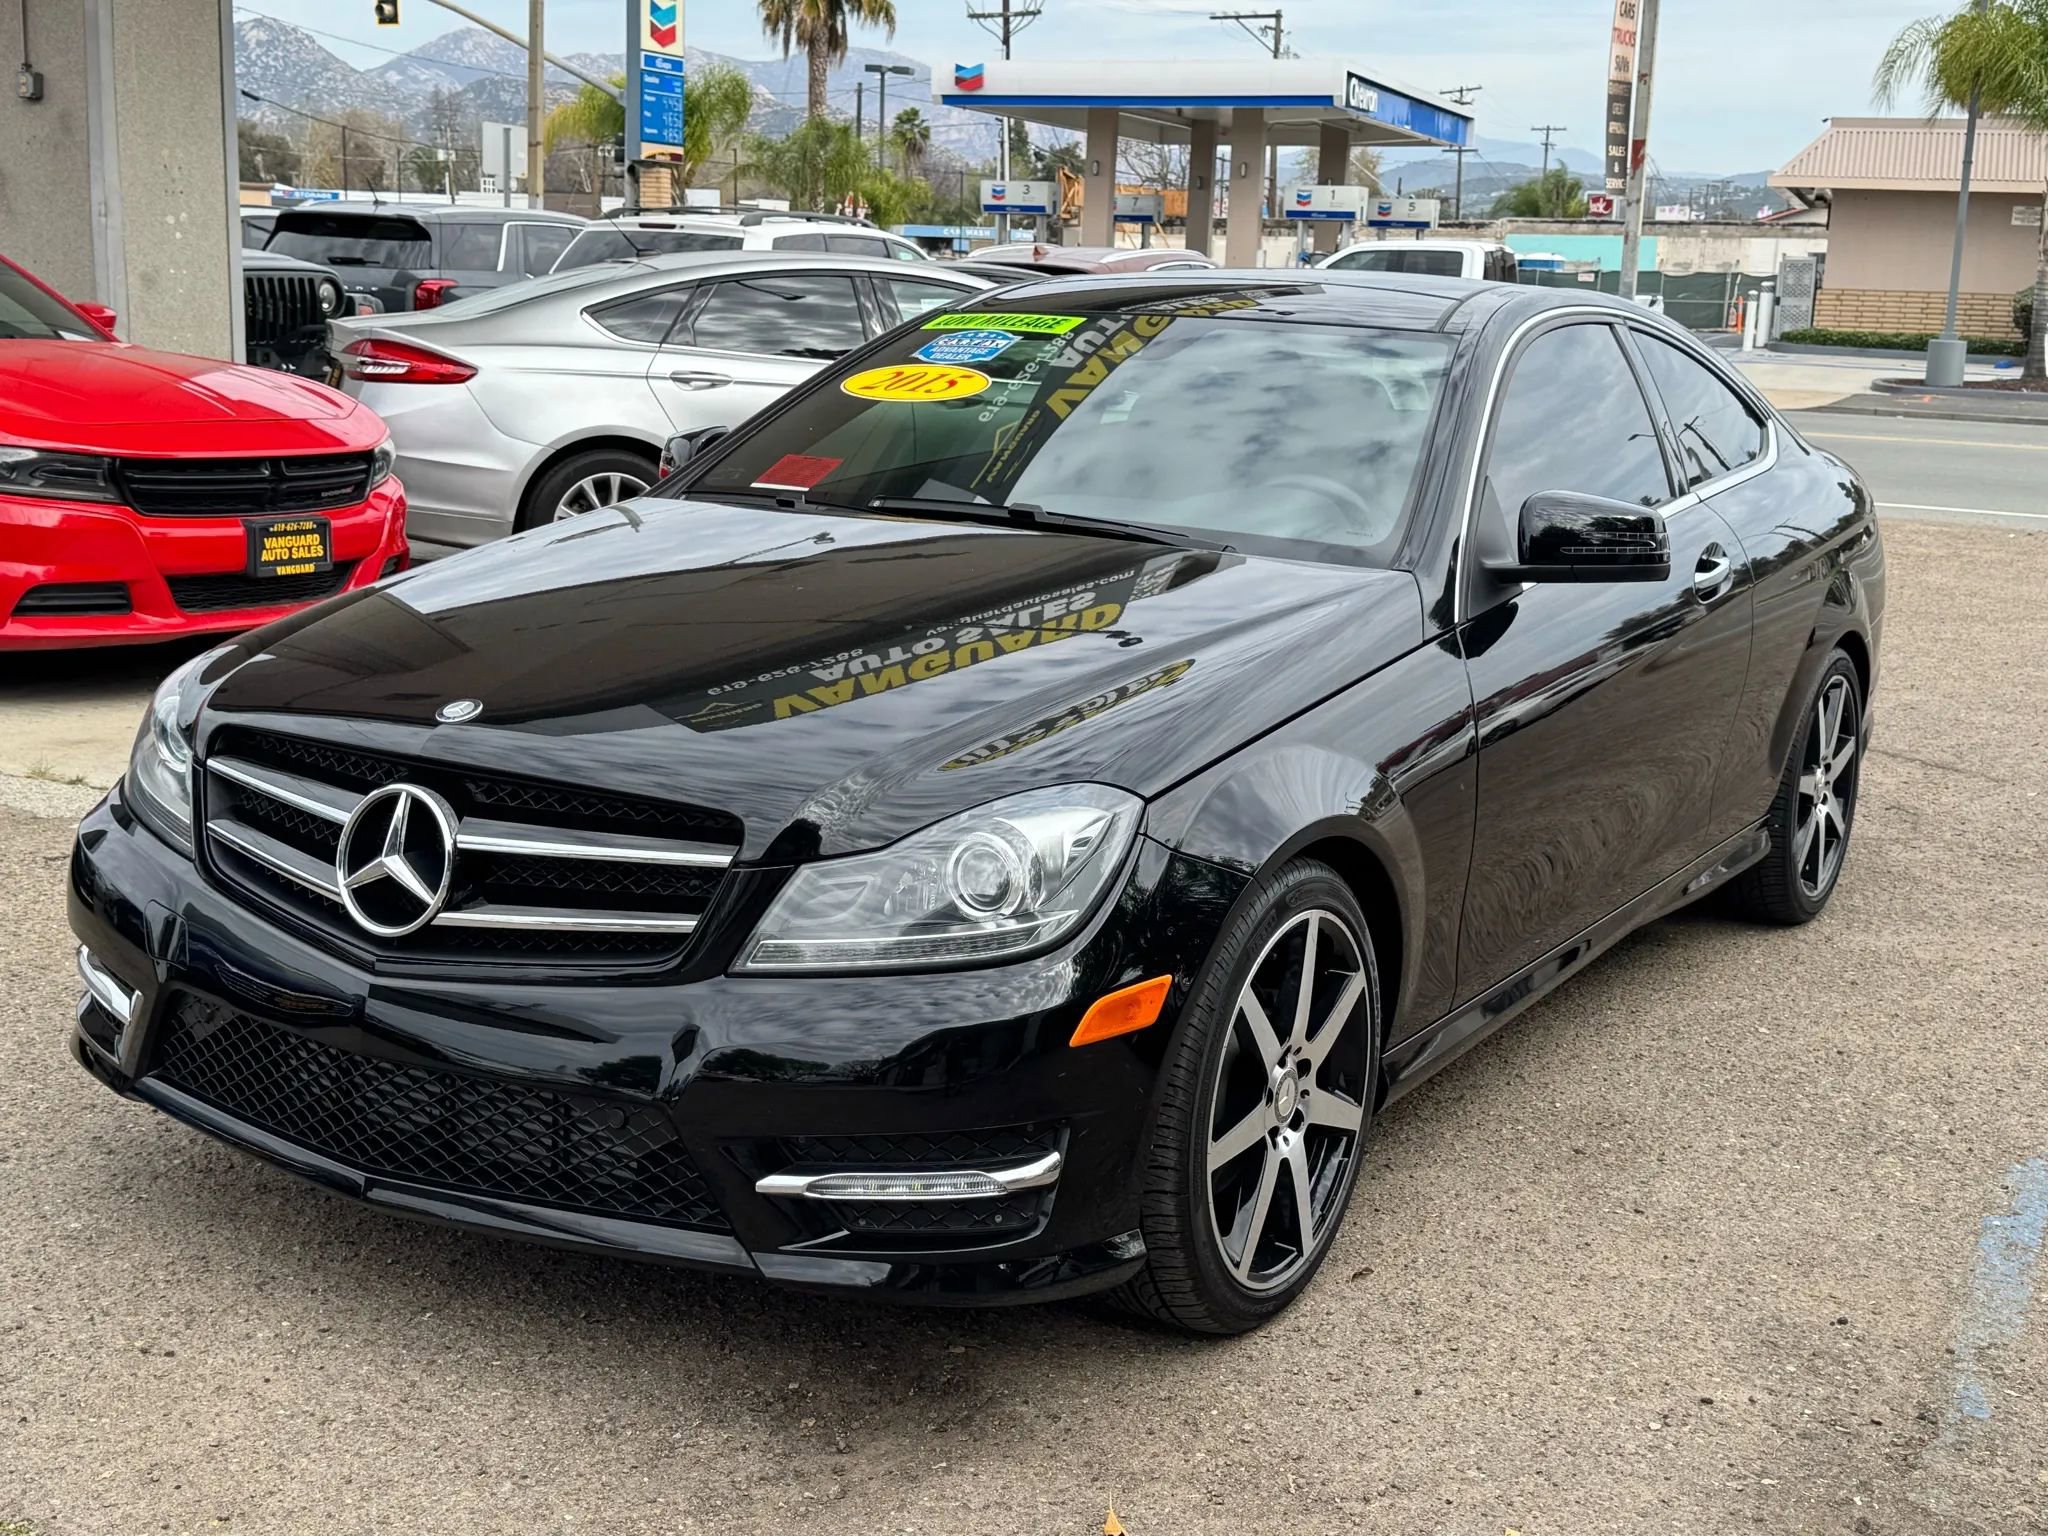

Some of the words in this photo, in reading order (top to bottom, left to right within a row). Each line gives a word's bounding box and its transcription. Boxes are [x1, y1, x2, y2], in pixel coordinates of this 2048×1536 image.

[1619, 1, 1636, 20] CARS
[1613, 27, 1637, 47] TRUCKS
[1607, 145, 1626, 157] SALES
[1023, 184, 1031, 195] 3
[1605, 177, 1627, 190] SERVIC
[1131, 196, 1140, 206] 7
[1329, 190, 1336, 201] 1
[1407, 202, 1416, 212] 5
[965, 228, 991, 237] WASH
[974, 316, 1068, 329] MILEAGE
[934, 337, 1006, 347] CARFAX
[930, 346, 989, 355] ADVANTAGE
[858, 371, 975, 394] 2015
[263, 534, 321, 549] VANGUARD
[261, 548, 290, 562] AUTO
[291, 545, 324, 559] SALES
[276, 563, 316, 576] VANGUARD
